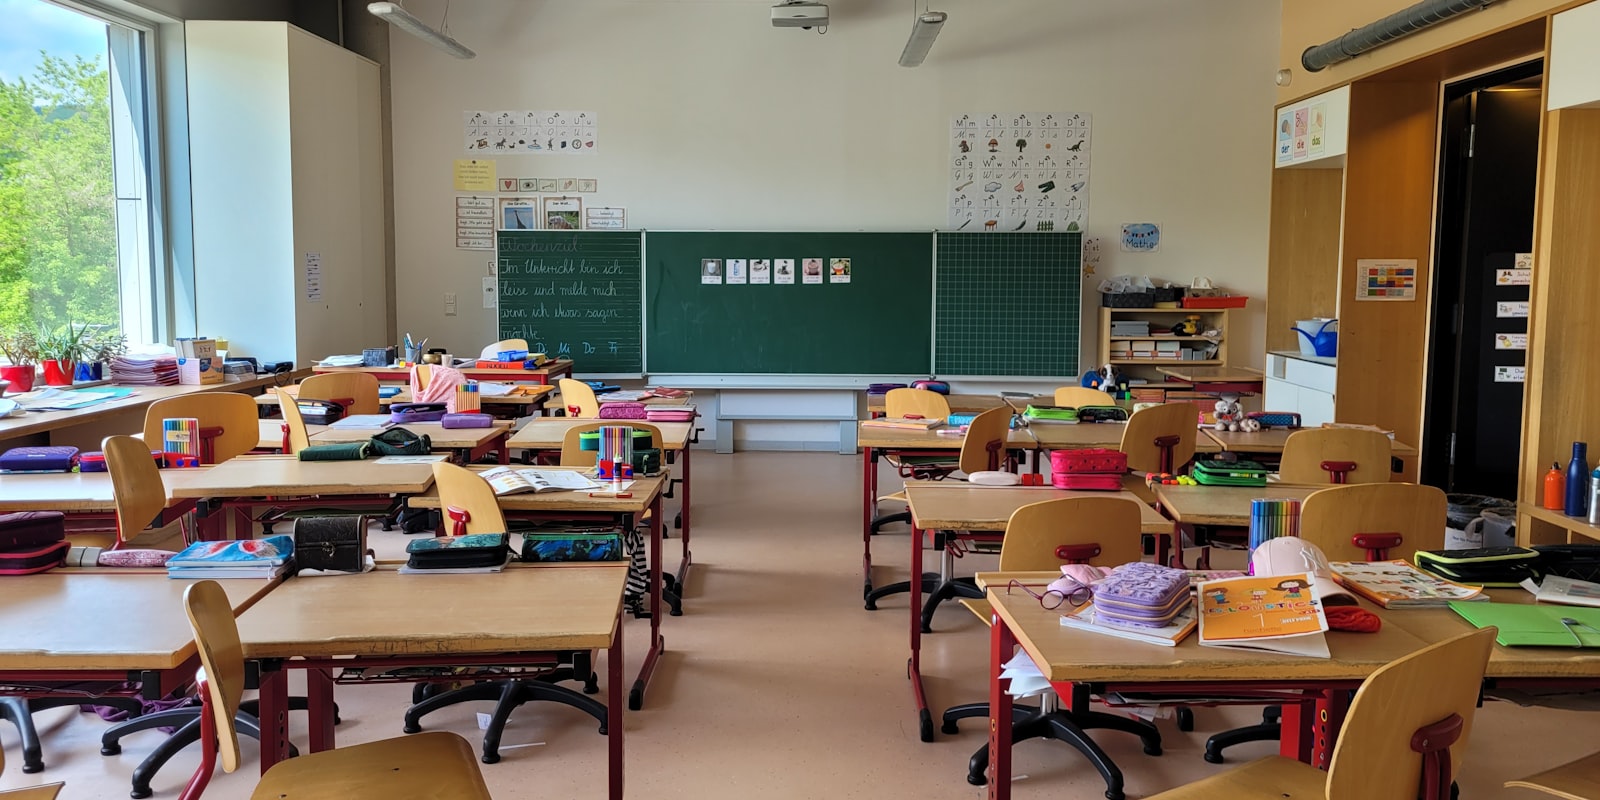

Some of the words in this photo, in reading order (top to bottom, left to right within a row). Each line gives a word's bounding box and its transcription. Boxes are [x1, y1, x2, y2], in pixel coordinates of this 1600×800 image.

[1281, 143, 1290, 154] der
[1312, 136, 1320, 146] das
[1126, 238, 1154, 249] Mathe
[500, 258, 519, 274] Im
[525, 258, 575, 274] Unterricht
[579, 259, 599, 274] bin
[602, 259, 623, 274] ich
[501, 280, 528, 296] leise
[534, 281, 555, 296] und
[502, 308, 527, 318] wenn
[531, 302, 549, 318] ich
[554, 303, 581, 318] etwas
[585, 308, 618, 323] sagen
[536, 342, 548, 354] Di
[558, 342, 570, 354] Mi
[582, 342, 596, 354] Do
[1253, 613, 1264, 628] 1
